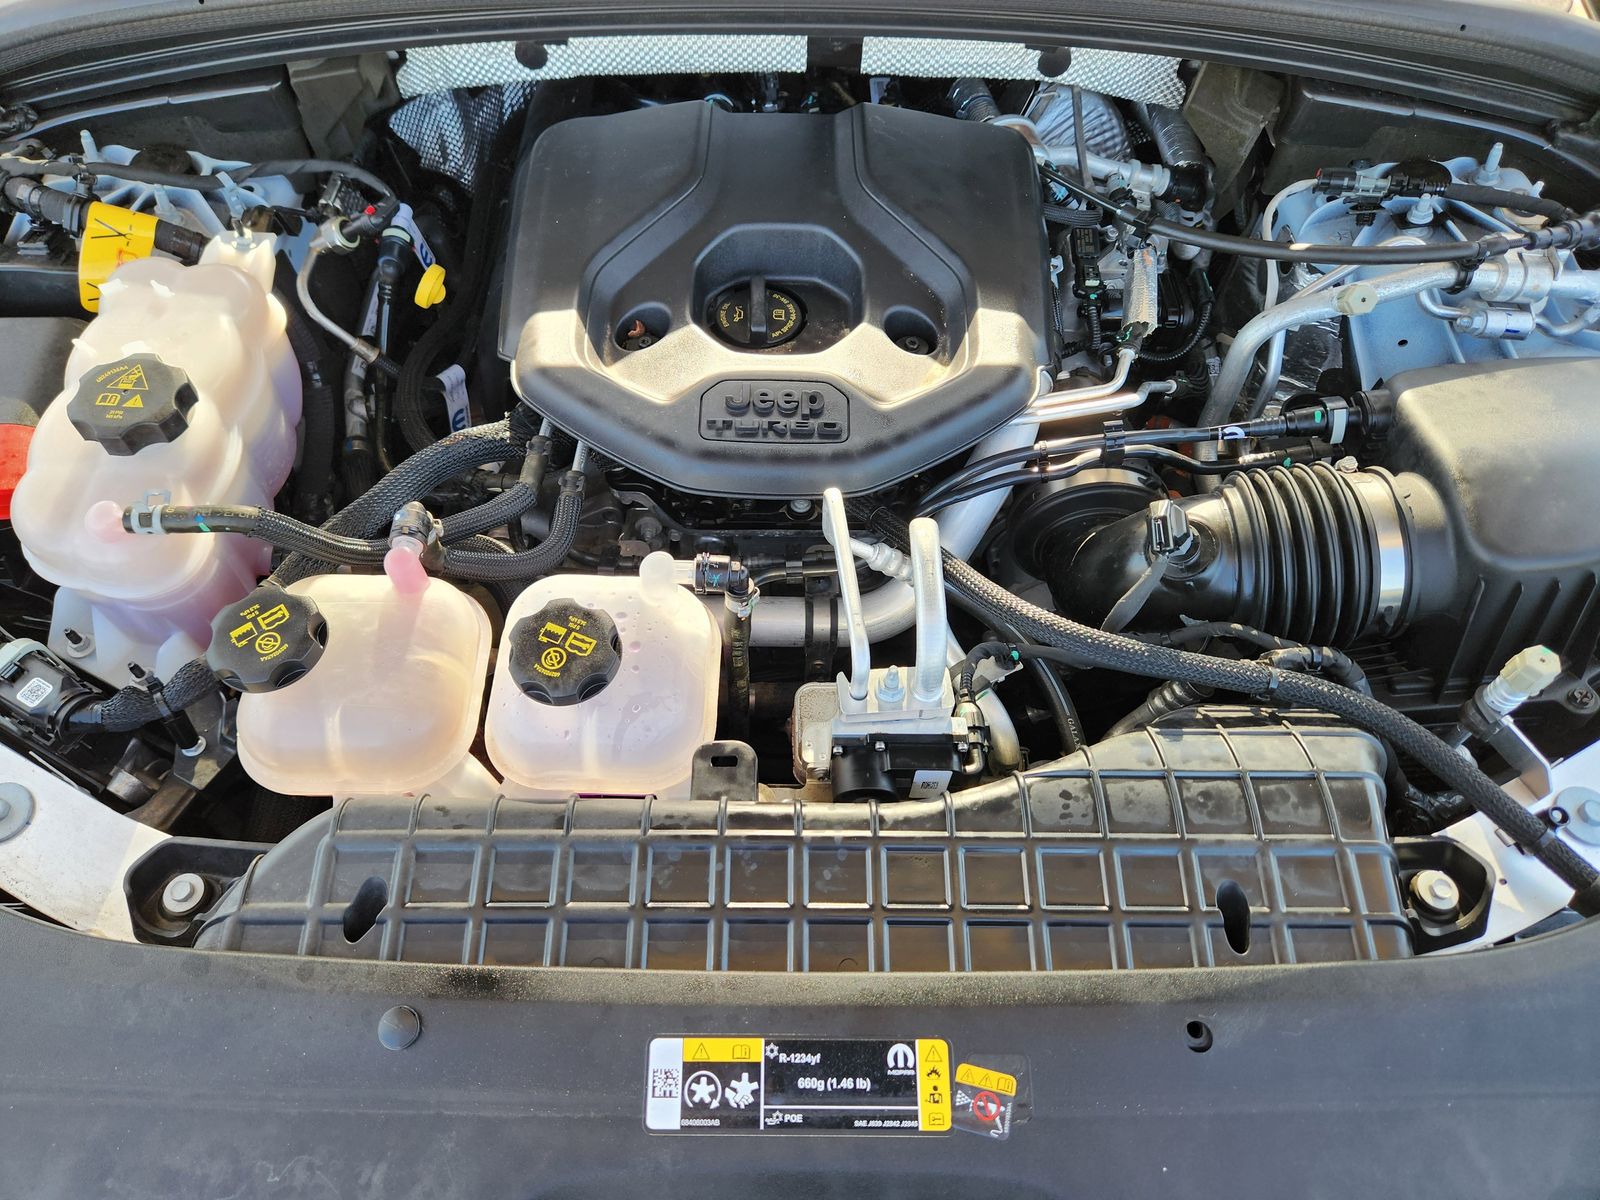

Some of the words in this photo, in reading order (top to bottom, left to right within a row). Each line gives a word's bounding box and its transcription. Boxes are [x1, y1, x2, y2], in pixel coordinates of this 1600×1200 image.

[722, 302, 731, 310] OIL
[720, 310, 730, 328] ENGINE
[724, 384, 825, 420] Jeep
[706, 419, 843, 440] TURBO
[779, 1053, 821, 1065] R-1234yf
[797, 1077, 825, 1091] 660g
[827, 1077, 854, 1091] (1.46
[856, 1077, 871, 1091] lb)
[784, 1114, 803, 1123] POE
